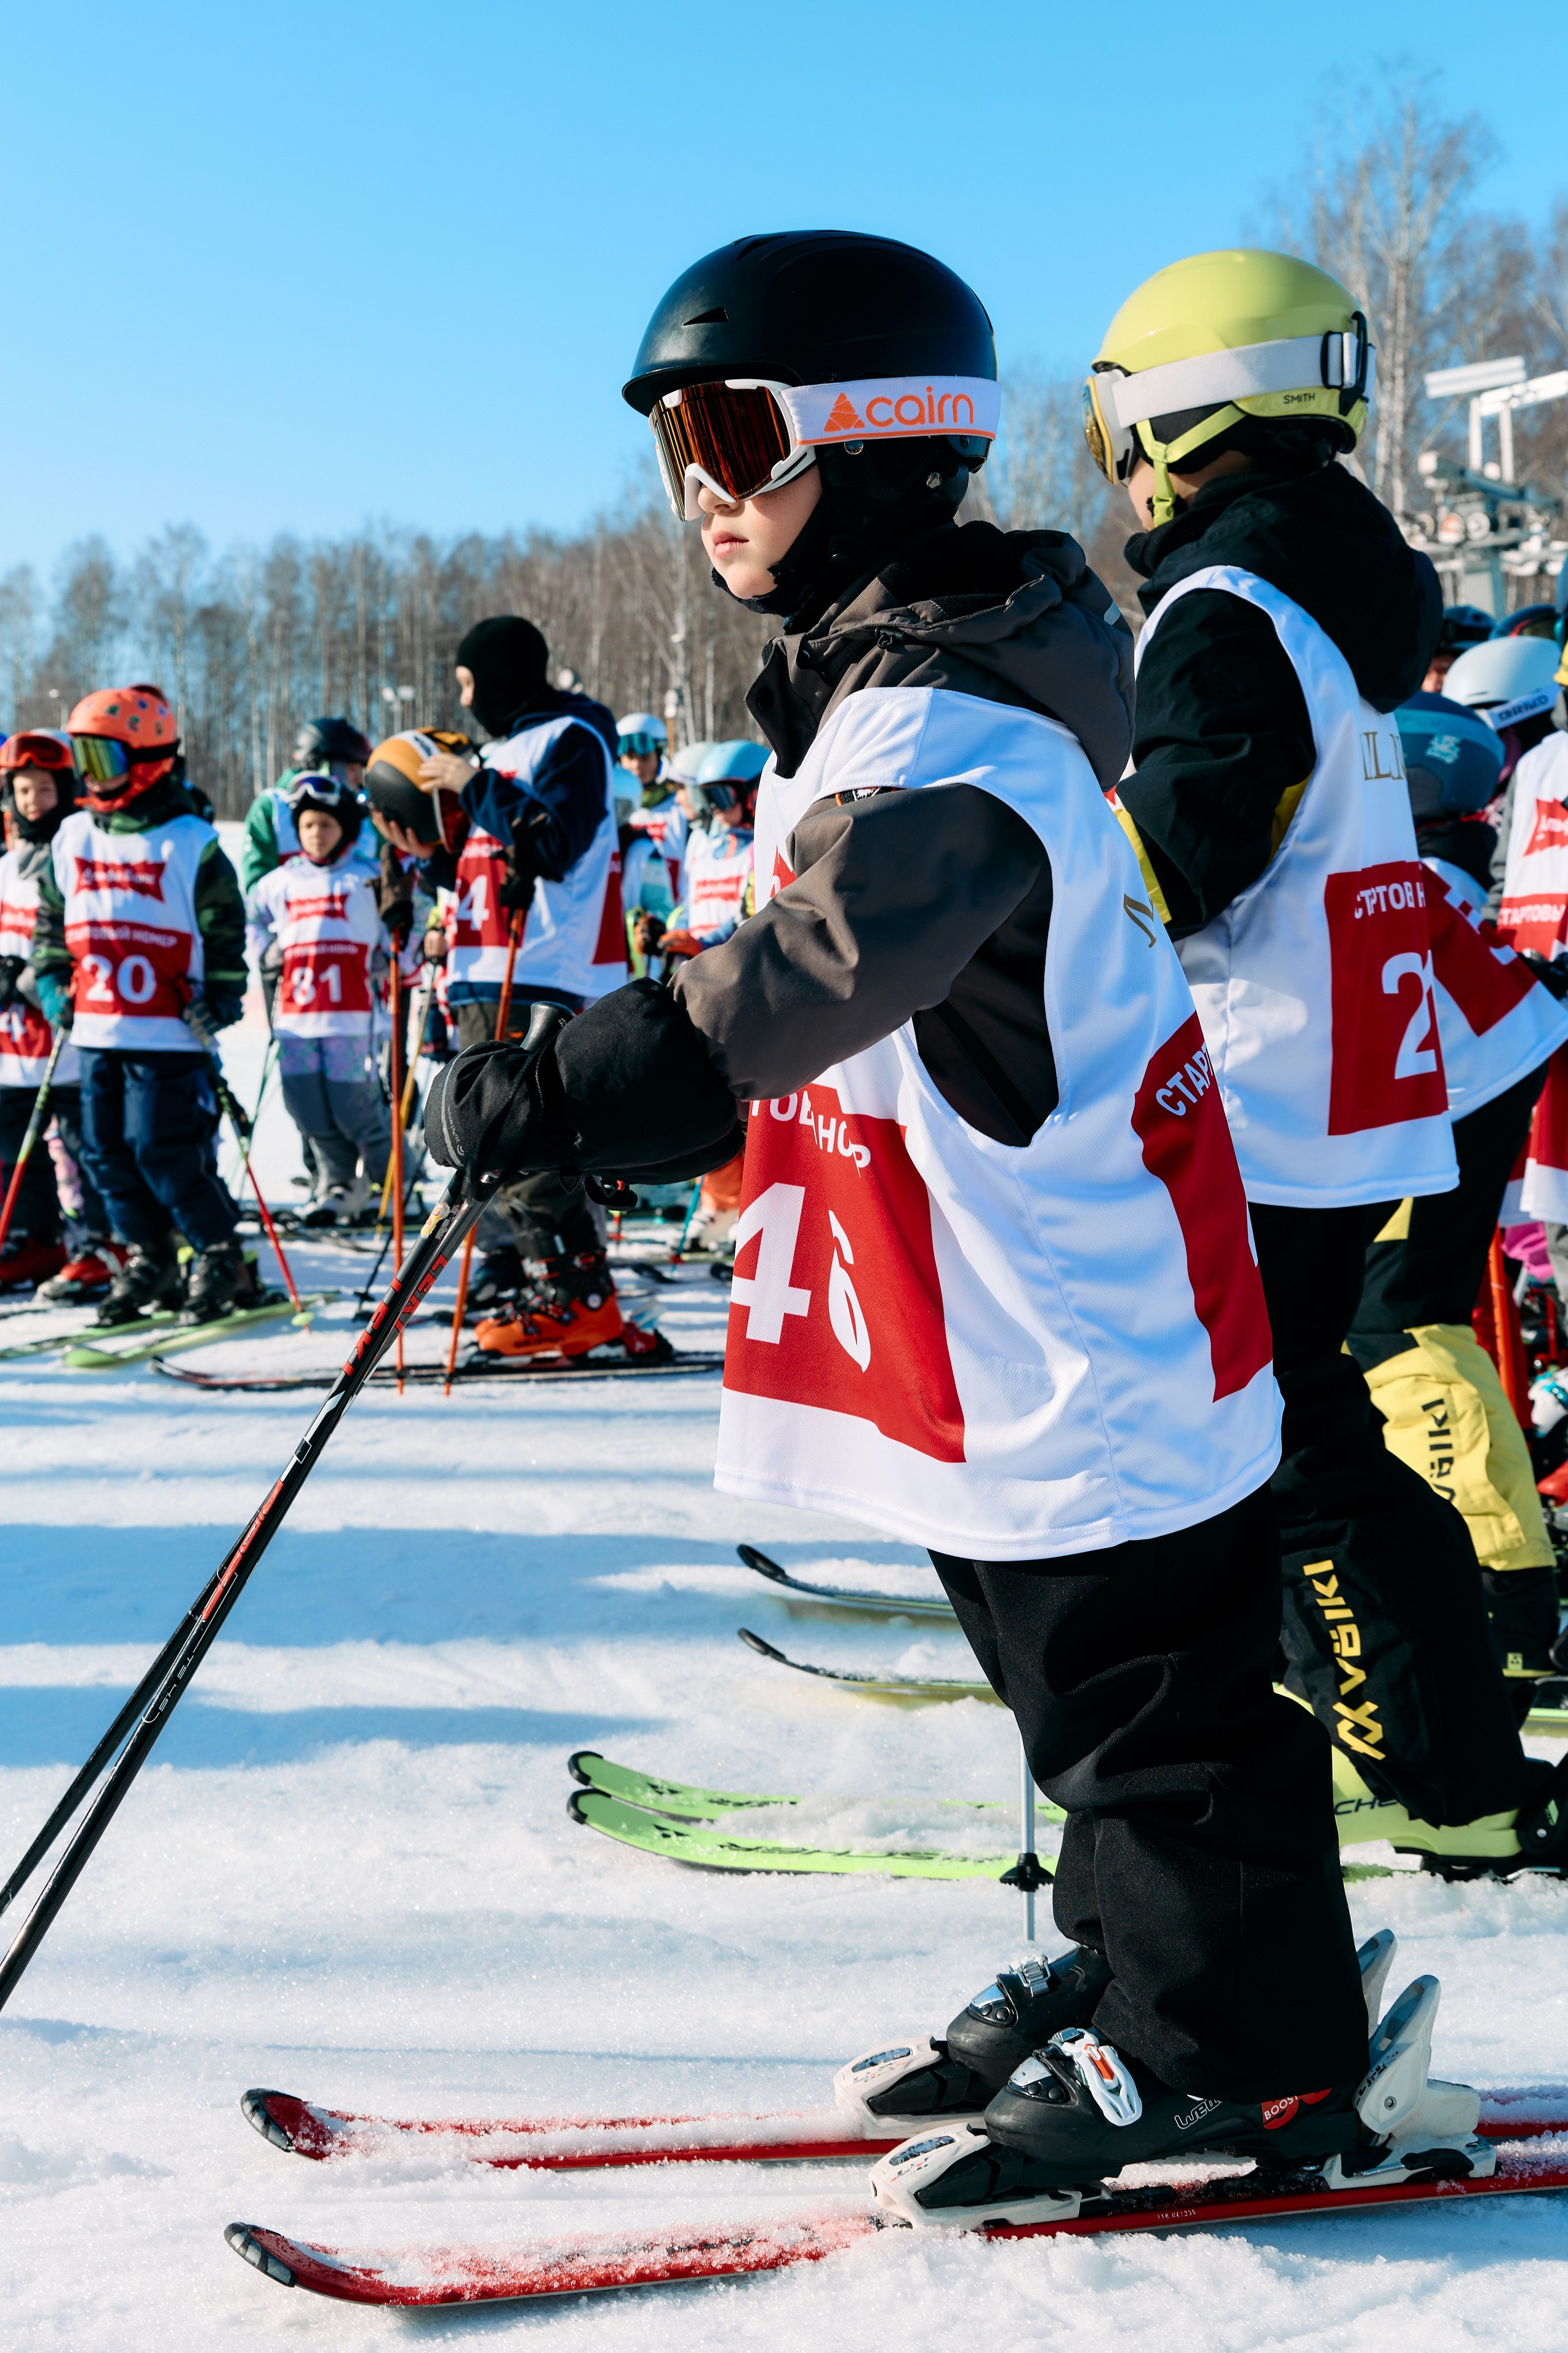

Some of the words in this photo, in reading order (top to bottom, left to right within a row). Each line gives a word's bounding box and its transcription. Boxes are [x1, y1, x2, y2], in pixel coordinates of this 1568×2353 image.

[866, 386, 974, 428] cairn
[1283, 392, 1316, 404] SMITH
[80, 953, 157, 1004] 20
[291, 963, 342, 1007] 81
